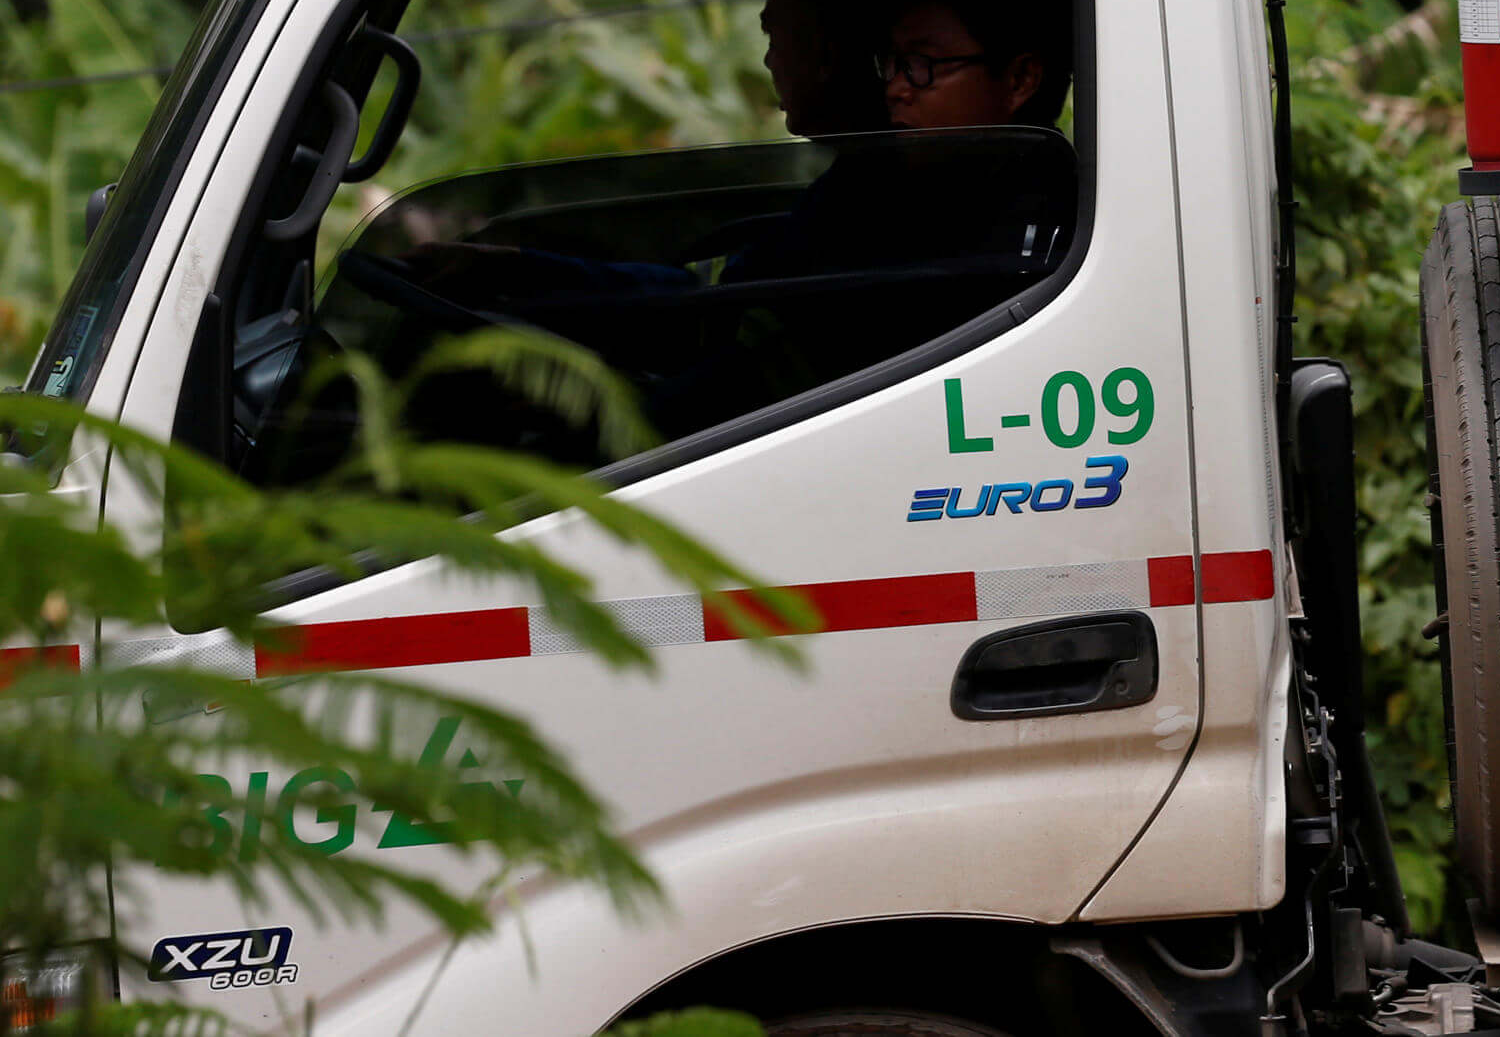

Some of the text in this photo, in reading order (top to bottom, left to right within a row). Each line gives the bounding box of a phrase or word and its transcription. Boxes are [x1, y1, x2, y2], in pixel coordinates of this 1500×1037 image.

[944, 367, 1155, 454] L-09
[160, 935, 281, 974] XZU
[211, 965, 298, 990] 600R
